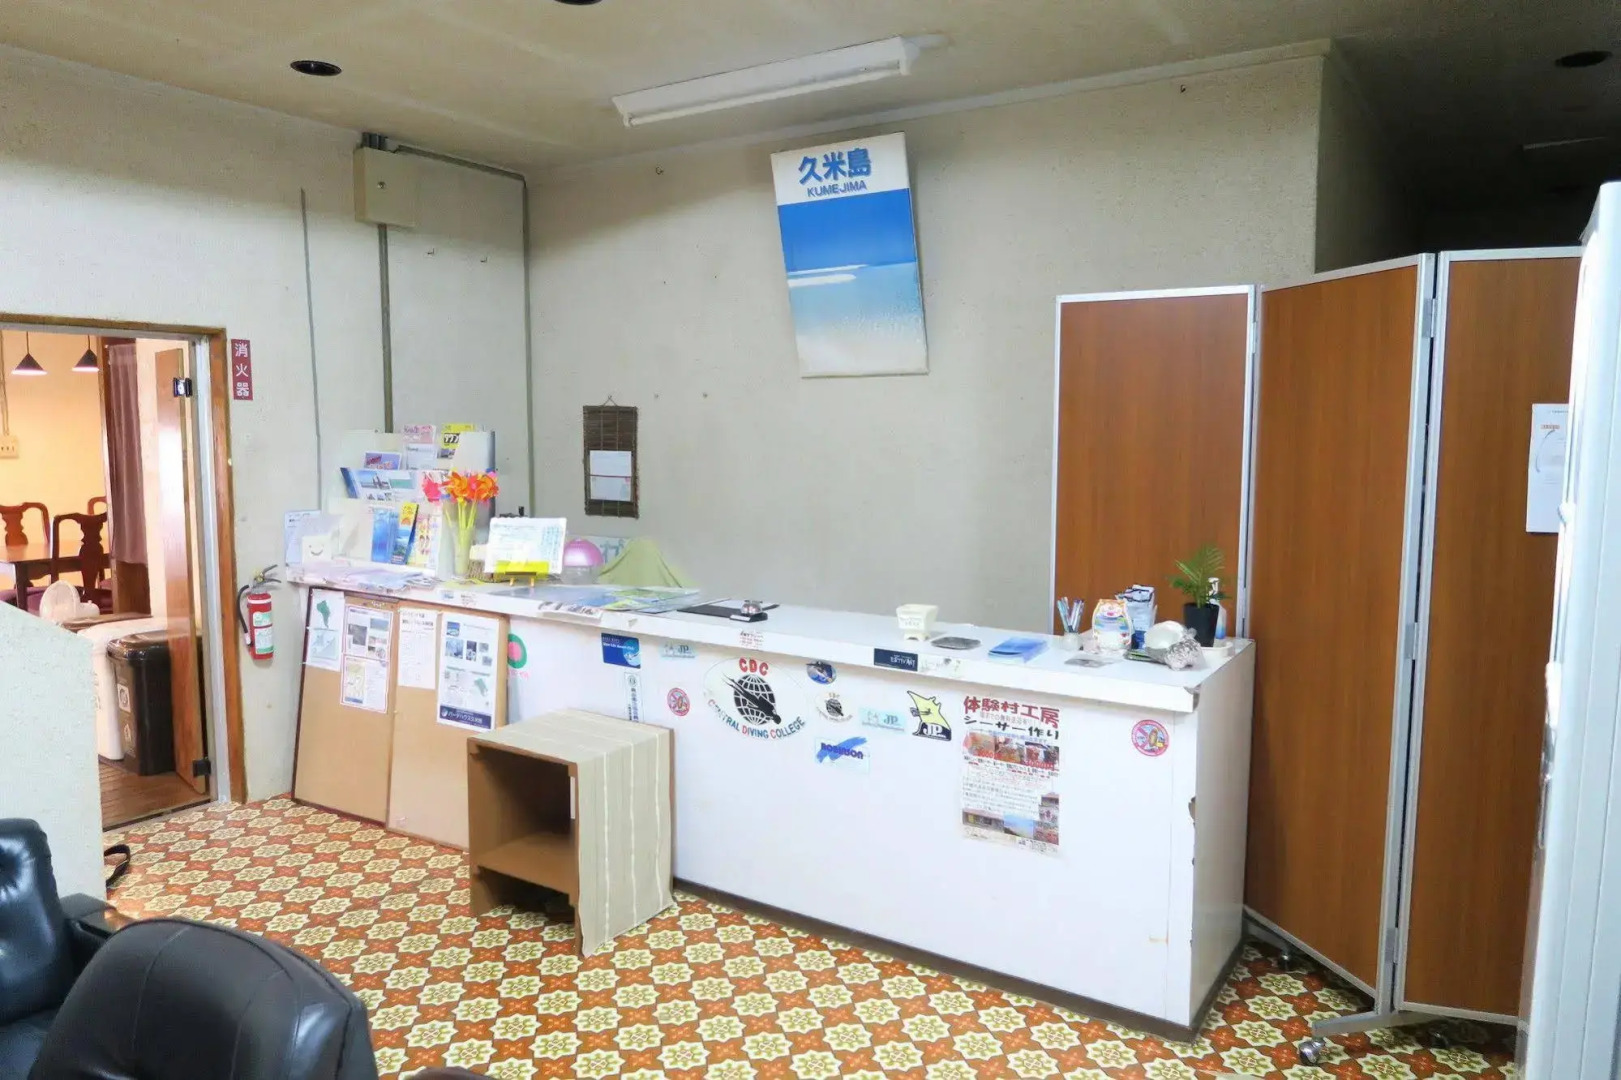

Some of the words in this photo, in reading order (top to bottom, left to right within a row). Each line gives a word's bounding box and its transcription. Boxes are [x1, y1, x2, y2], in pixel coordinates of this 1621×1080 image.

[798, 148, 872, 186] 久米島
[807, 180, 867, 197] KUMEJIMA
[235, 343, 250, 397] 消火器
[738, 656, 769, 676] CDC
[963, 695, 1060, 729] 体験村工房
[741, 725, 769, 739] DIVING
[769, 715, 806, 739] COLLEGE
[922, 723, 943, 736] JP
[963, 715, 1060, 740] シーサー作り
